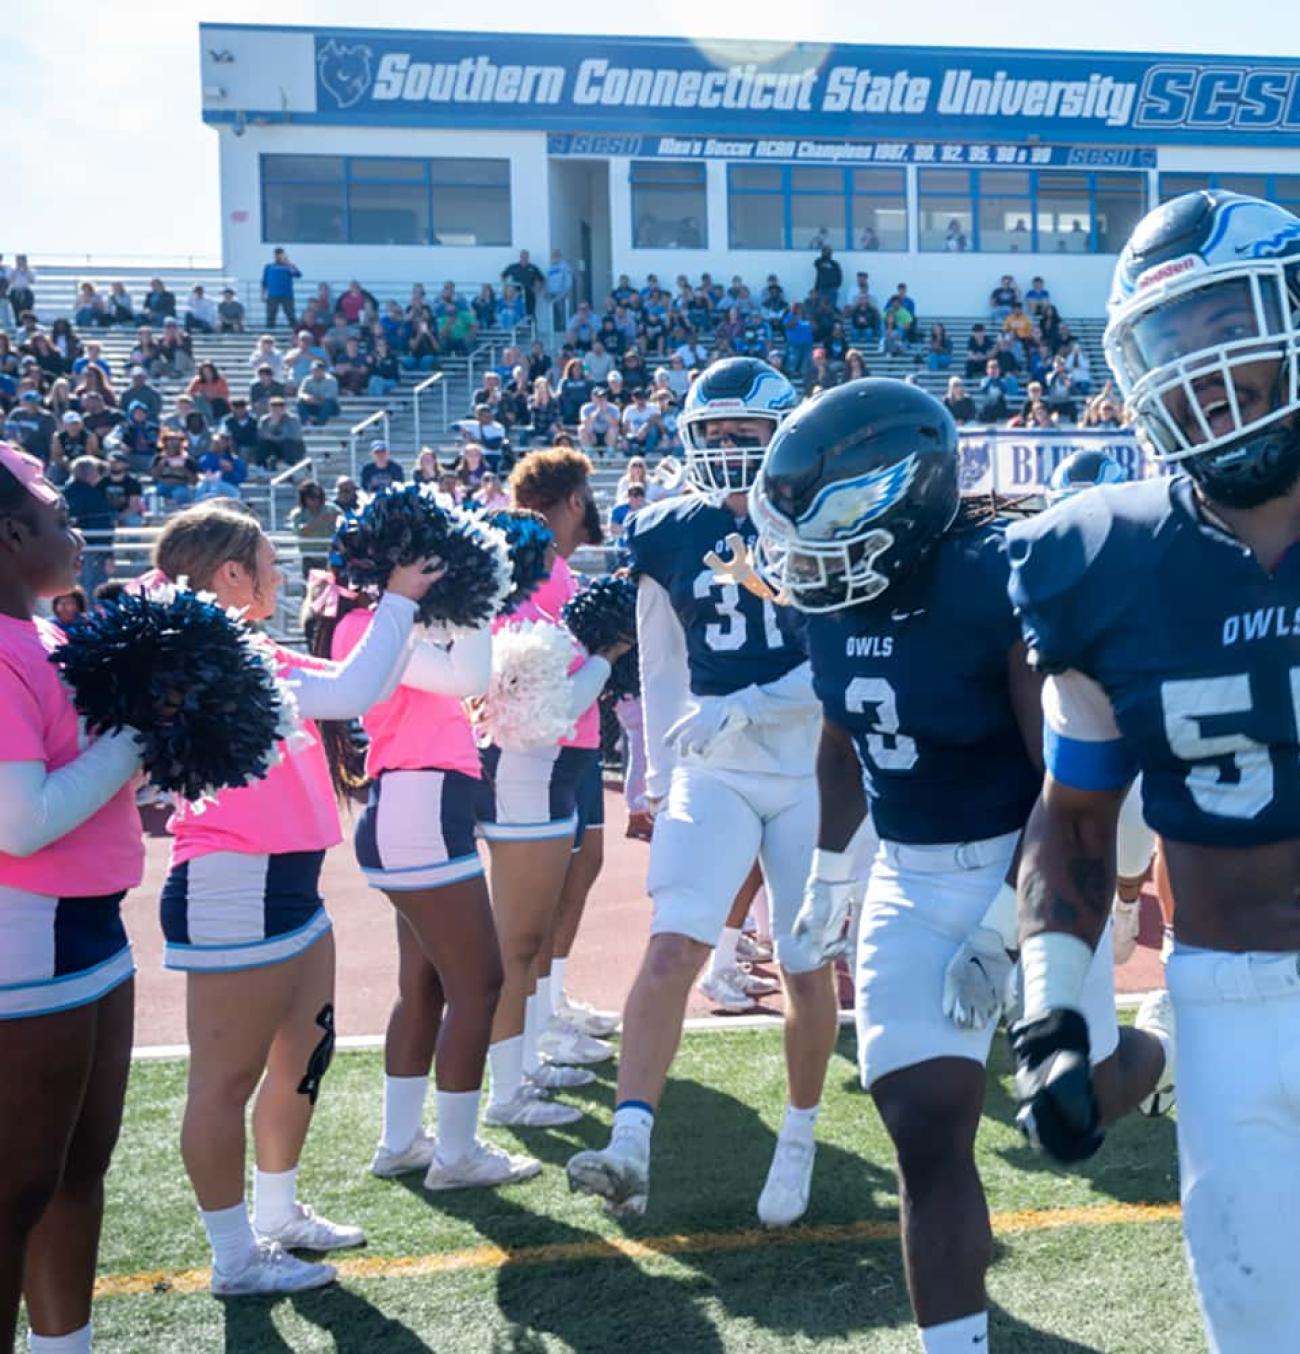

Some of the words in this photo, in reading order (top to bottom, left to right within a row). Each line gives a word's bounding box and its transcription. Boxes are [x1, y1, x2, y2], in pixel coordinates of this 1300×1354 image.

[372, 53, 566, 104] Southern
[574, 58, 817, 110] Connecticut
[822, 66, 931, 113] State
[937, 69, 1136, 126] University
[703, 139, 755, 157] Soccer
[715, 535, 757, 553] OS
[845, 636, 893, 658] OWLS
[844, 677, 920, 770] 3
